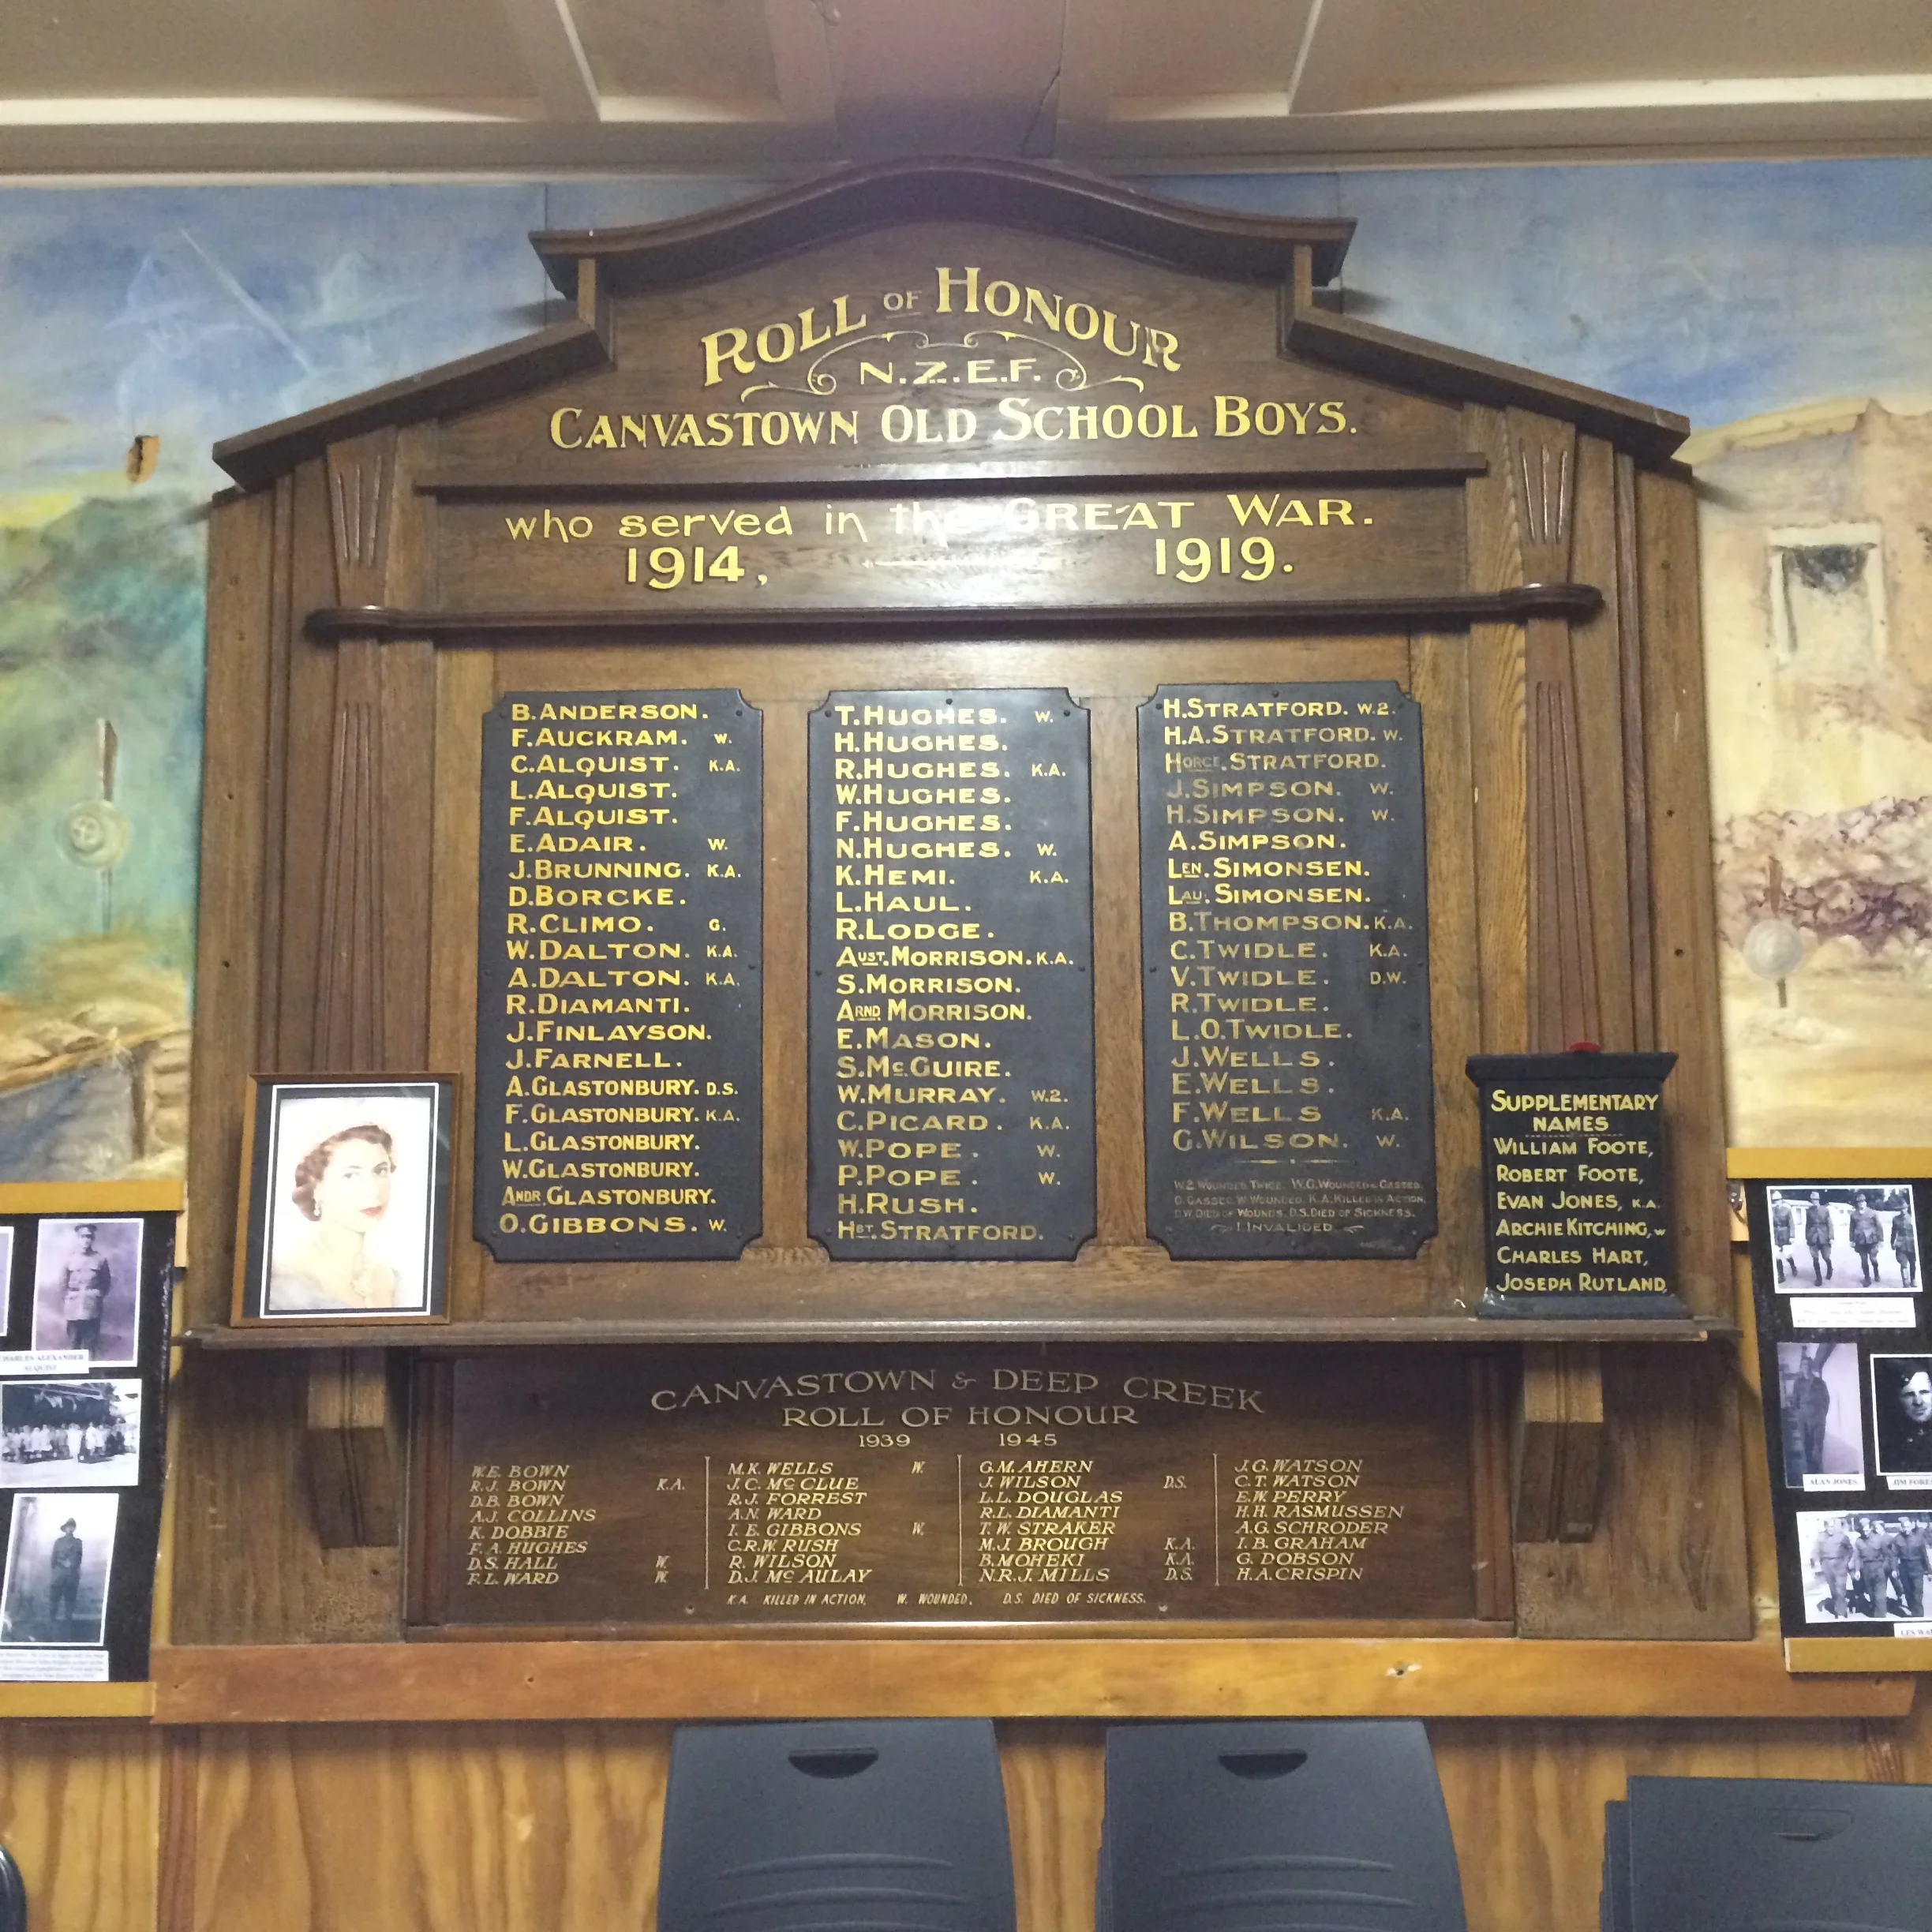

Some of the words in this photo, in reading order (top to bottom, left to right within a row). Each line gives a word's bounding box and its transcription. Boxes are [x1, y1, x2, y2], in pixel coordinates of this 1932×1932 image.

[701, 294, 867, 387] ROLL
[882, 290, 922, 312] OF
[936, 267, 1181, 372] HONOUR
[860, 358, 1041, 384] N.Z.E.F.
[550, 407, 859, 450] CANVASTOWN
[882, 406, 977, 444] OLD
[993, 398, 1198, 441] SCHOOL
[1215, 394, 1357, 437] BOYS.
[506, 509, 593, 542] who
[619, 506, 792, 537] served
[826, 504, 867, 542] in
[1002, 497, 1195, 533] GREAT
[1226, 492, 1373, 527] WAR.
[627, 546, 768, 590] 1914,
[1155, 536, 1293, 583] 1919.
[1357, 703, 1395, 716] W.2.
[1035, 711, 1054, 723] W.
[714, 733, 732, 743] W.
[1383, 730, 1402, 740] W.
[709, 760, 740, 772] K.A.
[1032, 763, 1065, 777] K.A.
[1370, 783, 1394, 795] W.
[1372, 809, 1395, 822] W.
[708, 838, 728, 850] W.
[1036, 844, 1057, 856] W.
[707, 864, 740, 878] K.A.
[1029, 871, 1069, 883] K.A.
[709, 919, 725, 931] G.
[1374, 916, 1413, 930] K.A.
[706, 945, 737, 957] K.A.
[1369, 945, 1407, 957] K.A.
[706, 973, 739, 986] K.A.
[1370, 972, 1406, 984] D.W.
[706, 1083, 738, 1095] D.S.
[1031, 1089, 1068, 1102] W.2.
[1491, 1090, 1658, 1111] SUPPLEMENTARY
[706, 1110, 739, 1121] K.A.
[1371, 1107, 1408, 1121] K.A.
[1029, 1117, 1069, 1129] K.A.
[1533, 1116, 1609, 1132] NAMES
[1376, 1135, 1400, 1148] W.
[1493, 1137, 1577, 1155] WILLIAM
[1587, 1137, 1653, 1158] FOOTE,
[1037, 1145, 1060, 1158] W.
[1039, 1172, 1061, 1185] W.
[1496, 1164, 1567, 1182] ROBERT
[1578, 1165, 1644, 1185] FOOTE,
[1497, 1192, 1543, 1209] EVAN
[1552, 1191, 1623, 1211] JONES,
[709, 1219, 727, 1231] W.
[1496, 1219, 1563, 1237] ARCHIE
[1567, 1218, 1652, 1238] KITCHING,
[1497, 1246, 1582, 1264] CHARLES
[1592, 1247, 1649, 1266] HART,
[1496, 1273, 1572, 1292] JOSEPH
[651, 1369, 935, 1411] CANVASTOWN
[952, 1372, 976, 1390] &
[993, 1368, 1099, 1394] DEEP
[1124, 1376, 1265, 1413] CREEK
[782, 1407, 885, 1427] ROLL
[900, 1406, 953, 1428] OF
[968, 1406, 1139, 1426] HONOUR
[858, 1433, 911, 1447] 1939
[999, 1432, 1058, 1447] 1945
[508, 1465, 569, 1477] BOWN
[766, 1462, 833, 1475] WELLS
[1018, 1460, 1093, 1473] AHERN
[1272, 1459, 1364, 1473] WATSON
[507, 1479, 566, 1492] BOWN
[999, 1476, 1081, 1488] WILSON
[507, 1495, 564, 1507] BOWN
[766, 1492, 867, 1505] FORREST
[1015, 1491, 1122, 1503] DOUGLAS
[1272, 1490, 1347, 1503] PERRY
[507, 1509, 597, 1522] COLLINS
[766, 1507, 821, 1520] WARD
[1015, 1506, 1121, 1518] DIAMANTI
[491, 1525, 568, 1539] DOBBIE
[1274, 1521, 1388, 1534] SCHRODER
[781, 1539, 840, 1552] RUSH
[1017, 1537, 1110, 1552] BROUGH
[504, 1556, 558, 1571] HALL
[754, 1554, 837, 1568] WILSON
[1260, 1552, 1354, 1565] DOBSON
[504, 1572, 560, 1586] WARD
[1037, 1568, 1110, 1582] MILLS
